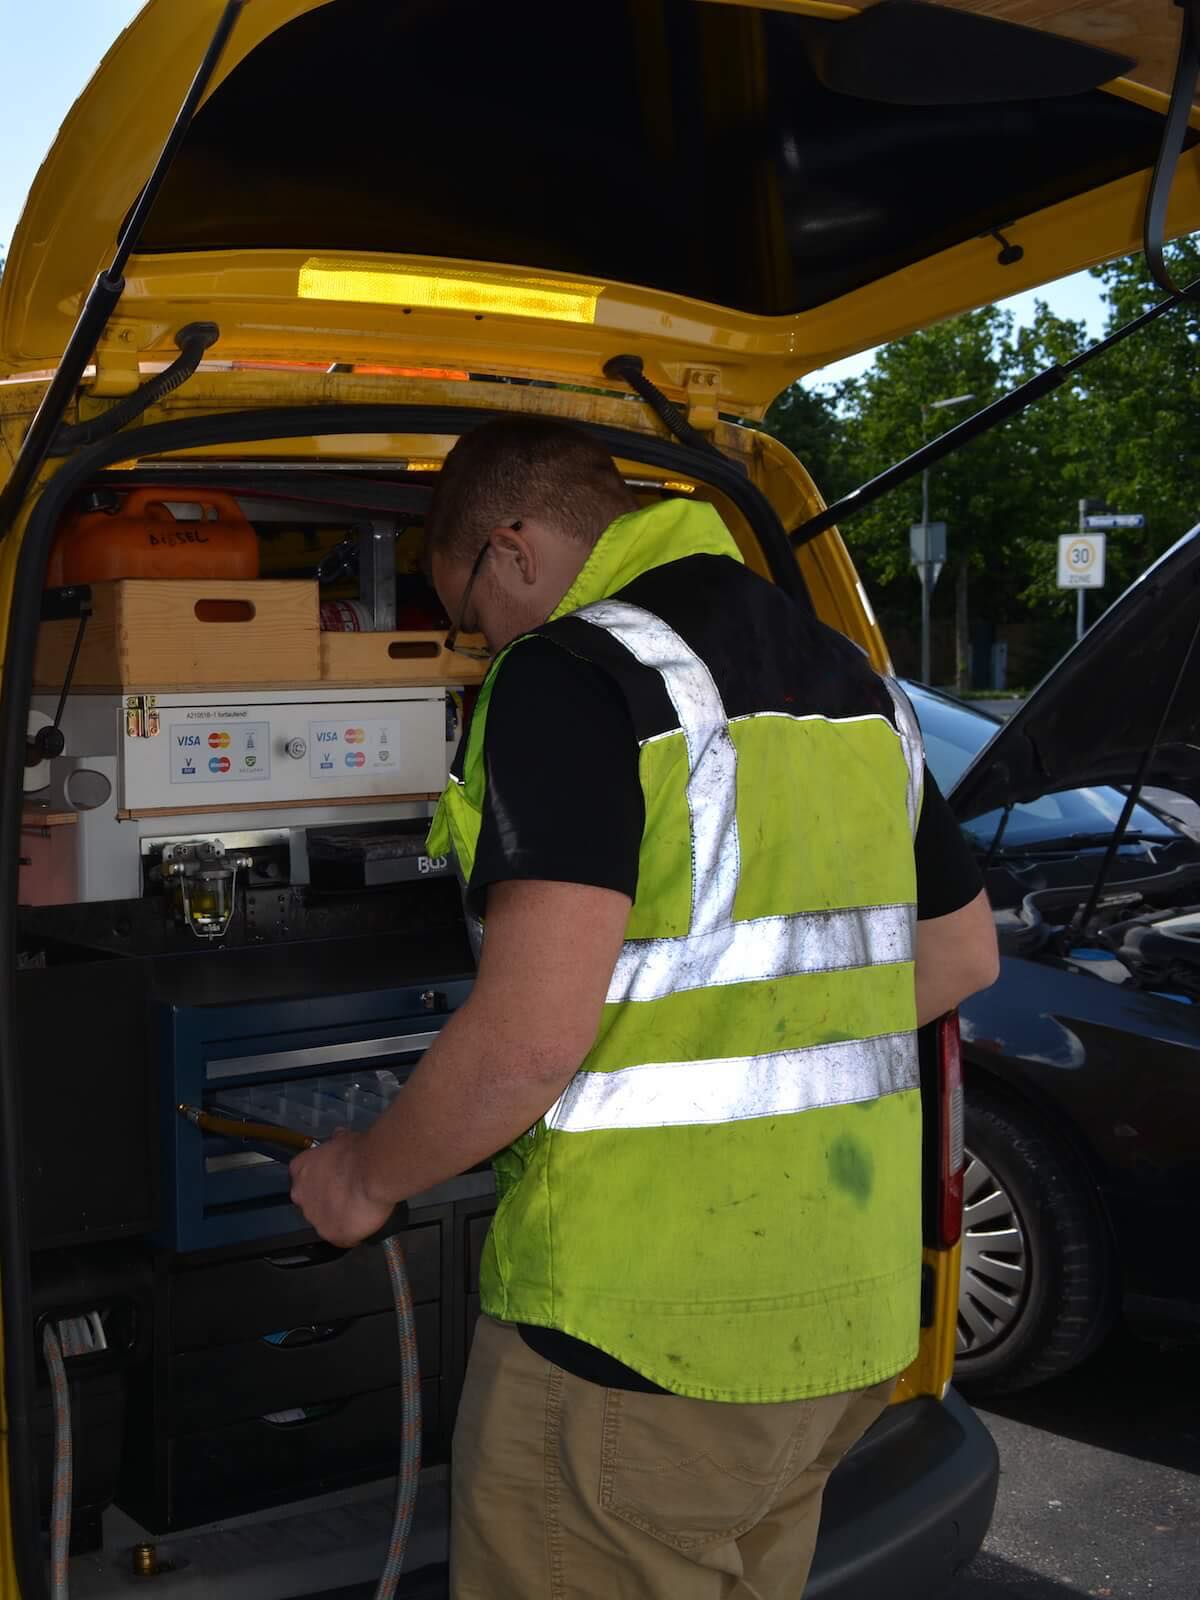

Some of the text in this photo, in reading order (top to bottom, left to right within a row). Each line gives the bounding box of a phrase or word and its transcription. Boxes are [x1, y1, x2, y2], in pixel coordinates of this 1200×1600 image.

[149, 530, 209, 546] DIESEL
[1071, 548, 1089, 564] 30
[1069, 574, 1091, 584] ZONE
[177, 735, 201, 746] VISA
[316, 731, 338, 741] VISA
